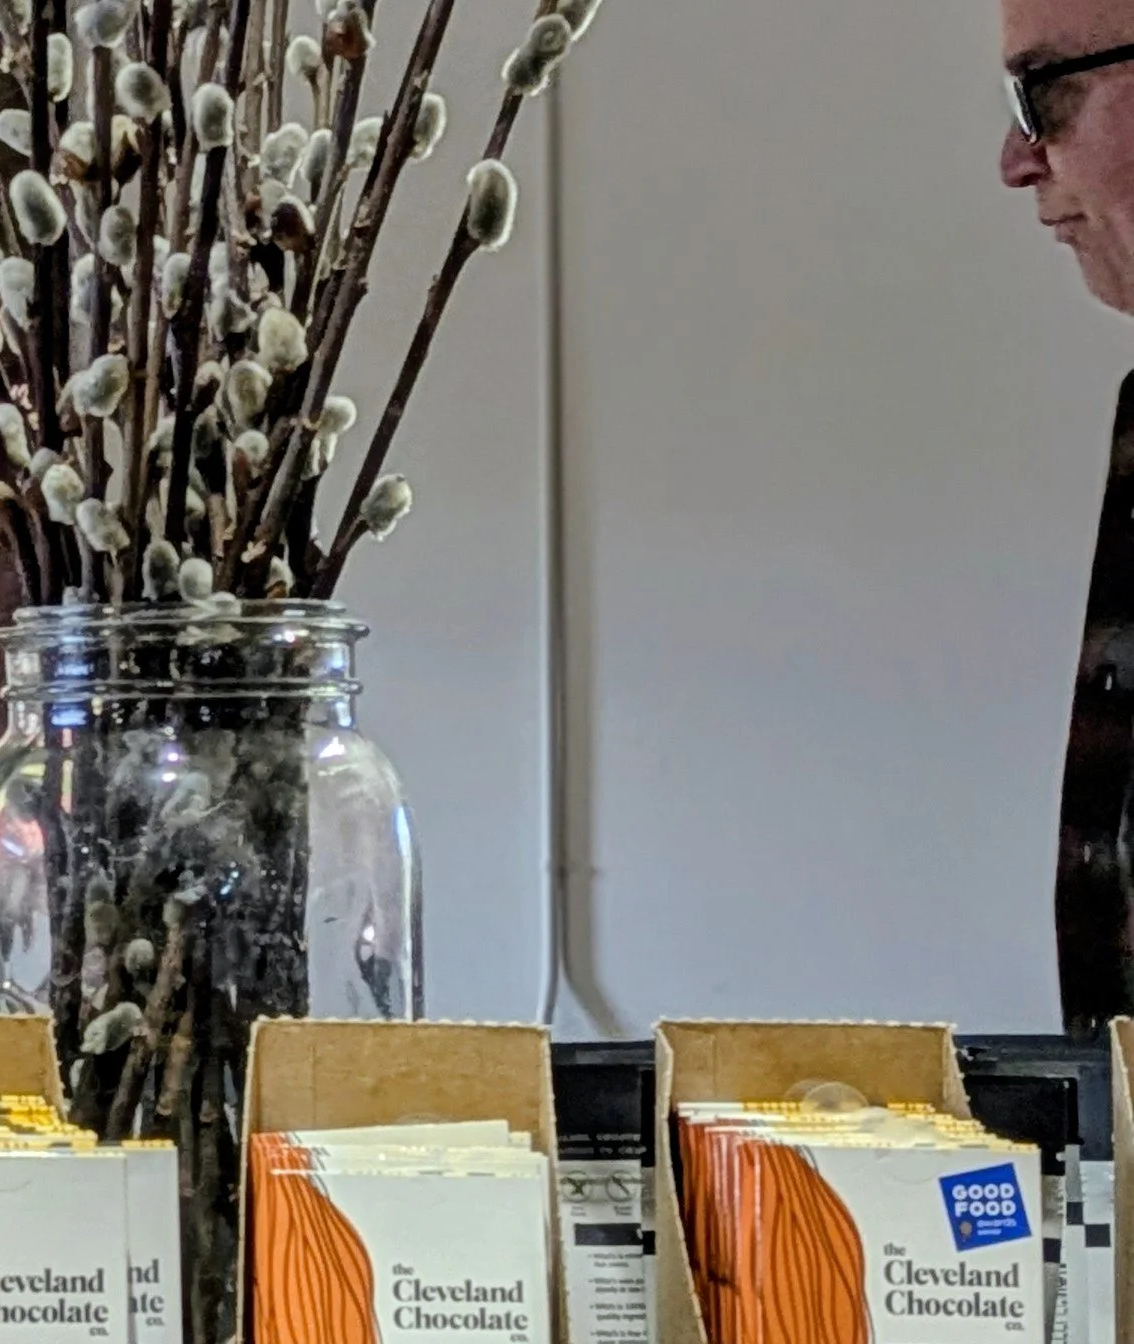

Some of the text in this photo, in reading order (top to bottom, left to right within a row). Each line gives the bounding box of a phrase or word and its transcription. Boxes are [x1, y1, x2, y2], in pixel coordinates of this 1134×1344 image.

[951, 1183, 1015, 1201] GOOD
[954, 1200, 1017, 1217] FOOD
[883, 1243, 906, 1256] the
[393, 1263, 413, 1276] the
[884, 1260, 1019, 1288] Cleveland
[392, 1279, 524, 1304] Cleveland
[884, 1291, 1024, 1318] Chocolate
[393, 1306, 528, 1331] Chocolate
